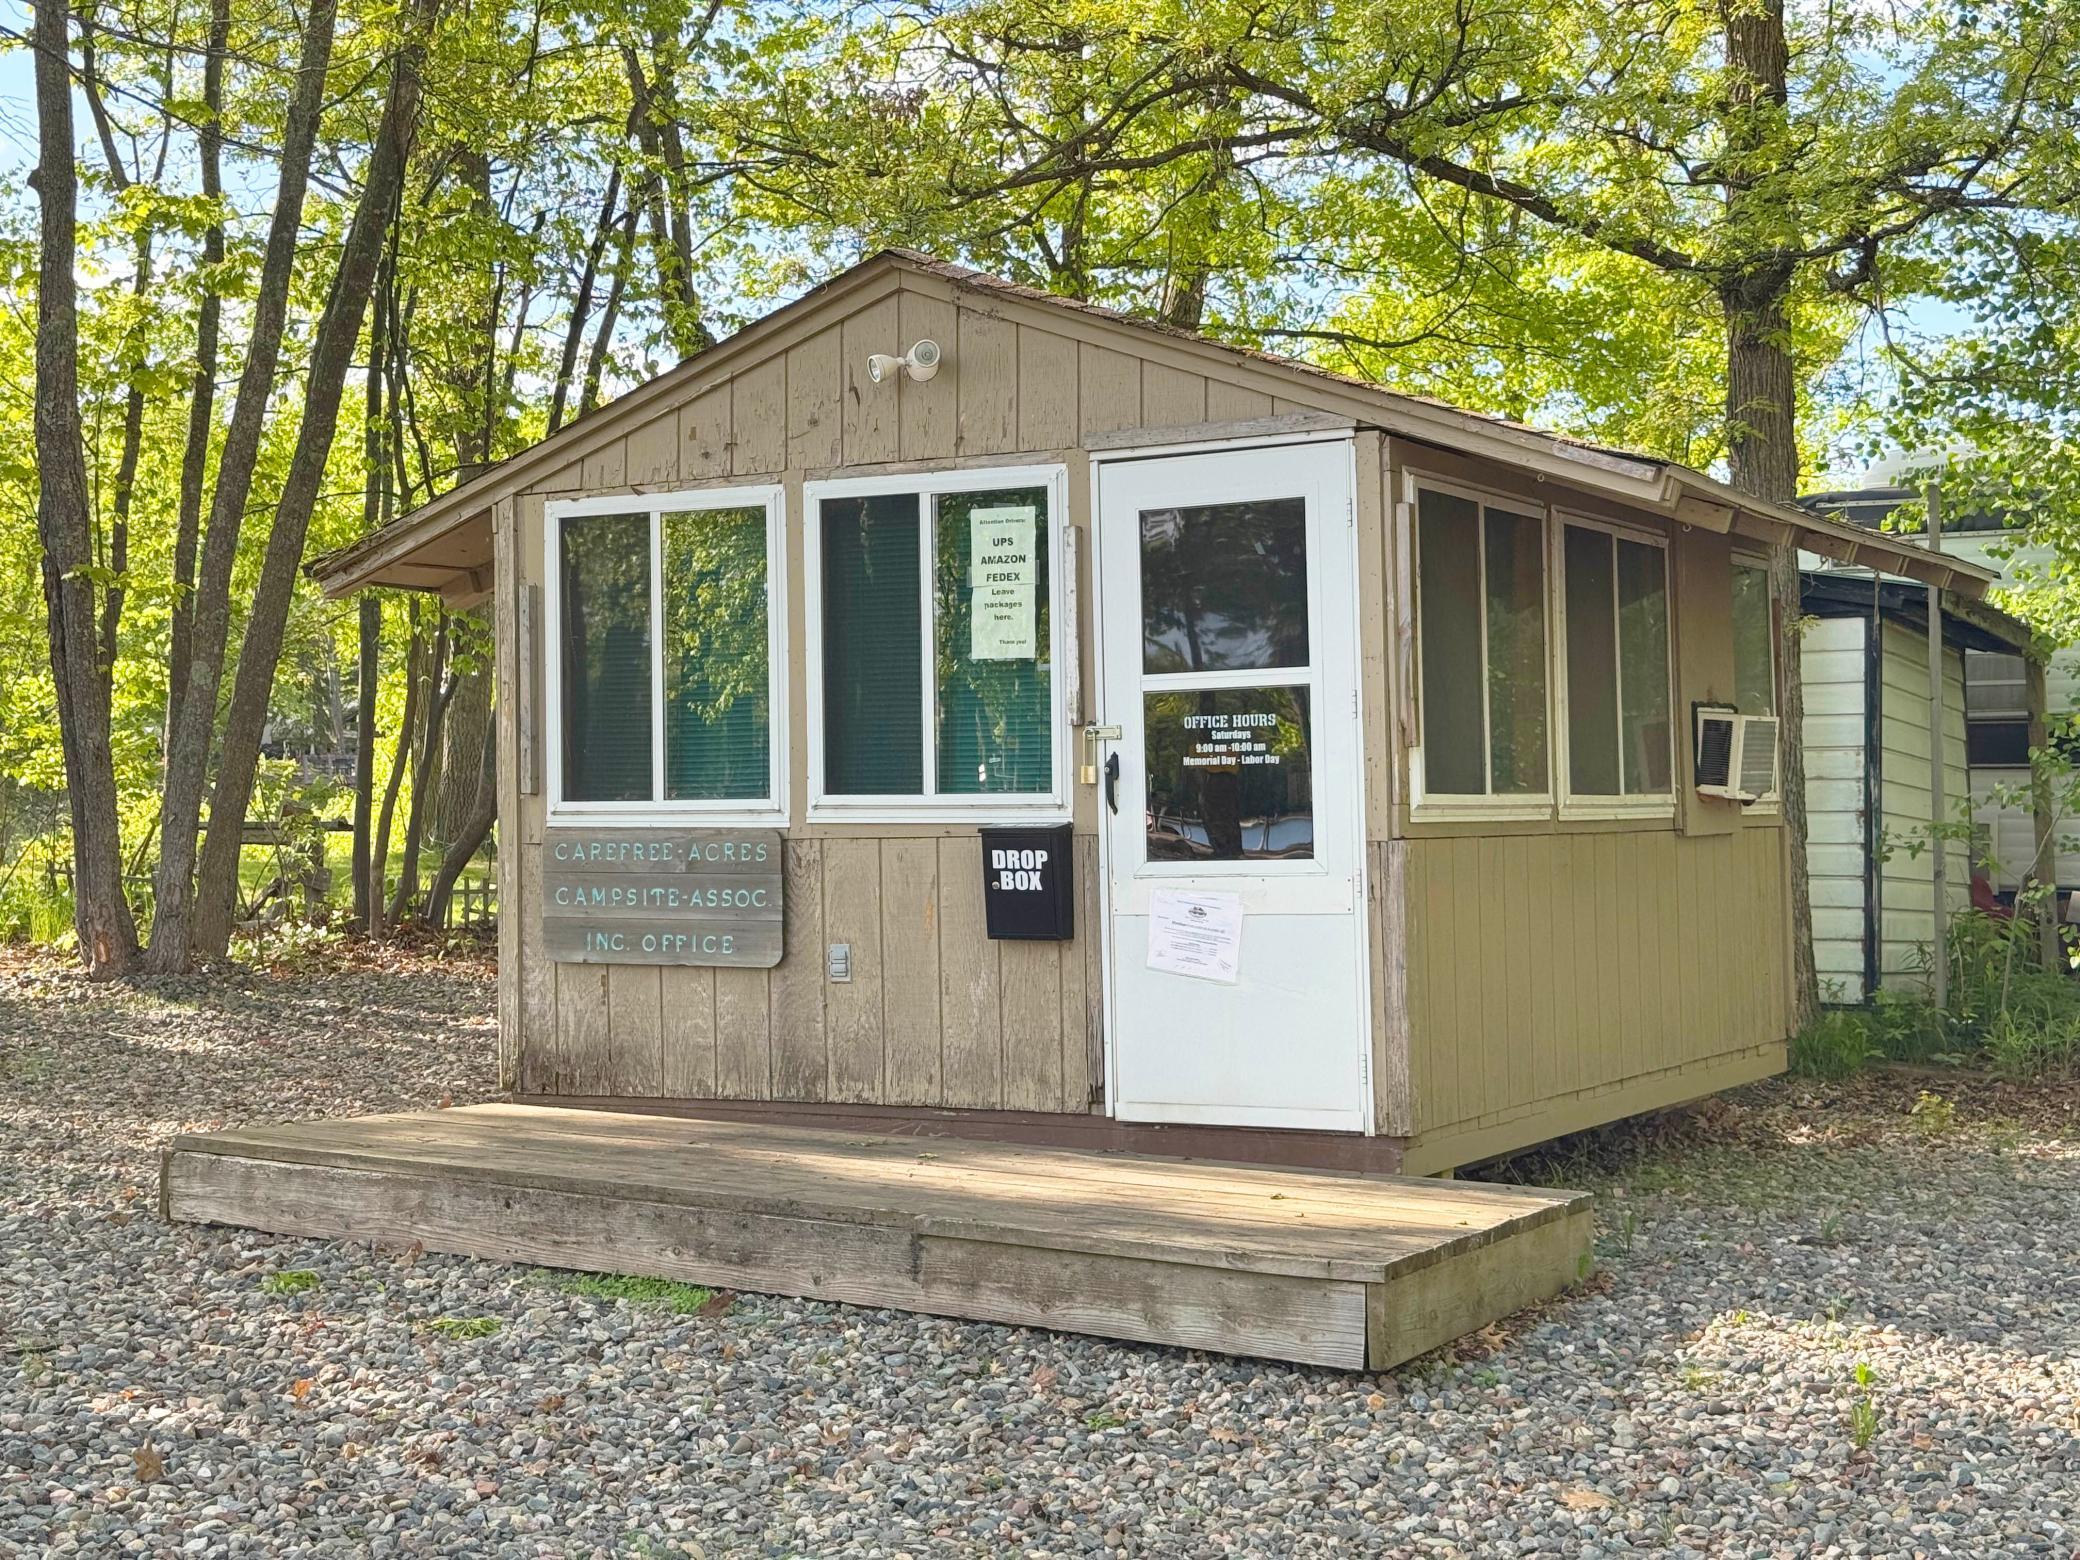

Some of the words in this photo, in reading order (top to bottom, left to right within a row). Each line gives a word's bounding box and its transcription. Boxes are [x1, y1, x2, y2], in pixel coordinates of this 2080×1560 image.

[992, 537, 1014, 547] UPS
[980, 554, 1026, 565] AMAZON
[986, 572, 1020, 582] FEDEX
[991, 588, 1015, 596] Leave
[984, 601, 1023, 610] packages
[994, 613, 1014, 621] here.
[1184, 714, 1228, 729] OFFICE
[1232, 713, 1276, 728] HOURS
[1211, 730, 1251, 740] Saturdays
[1195, 743, 1213, 753] 9:00
[1214, 743, 1227, 752] am
[1253, 742, 1266, 751] am
[1183, 755, 1220, 766] Memorial
[1221, 755, 1236, 766] Day
[1241, 754, 1263, 765] Labor
[1264, 754, 1280, 765] Day
[991, 849, 1049, 870] DROP
[1000, 870, 1043, 891] BOX
[586, 932, 631, 951] INC.
[641, 934, 734, 954] OFFICE
